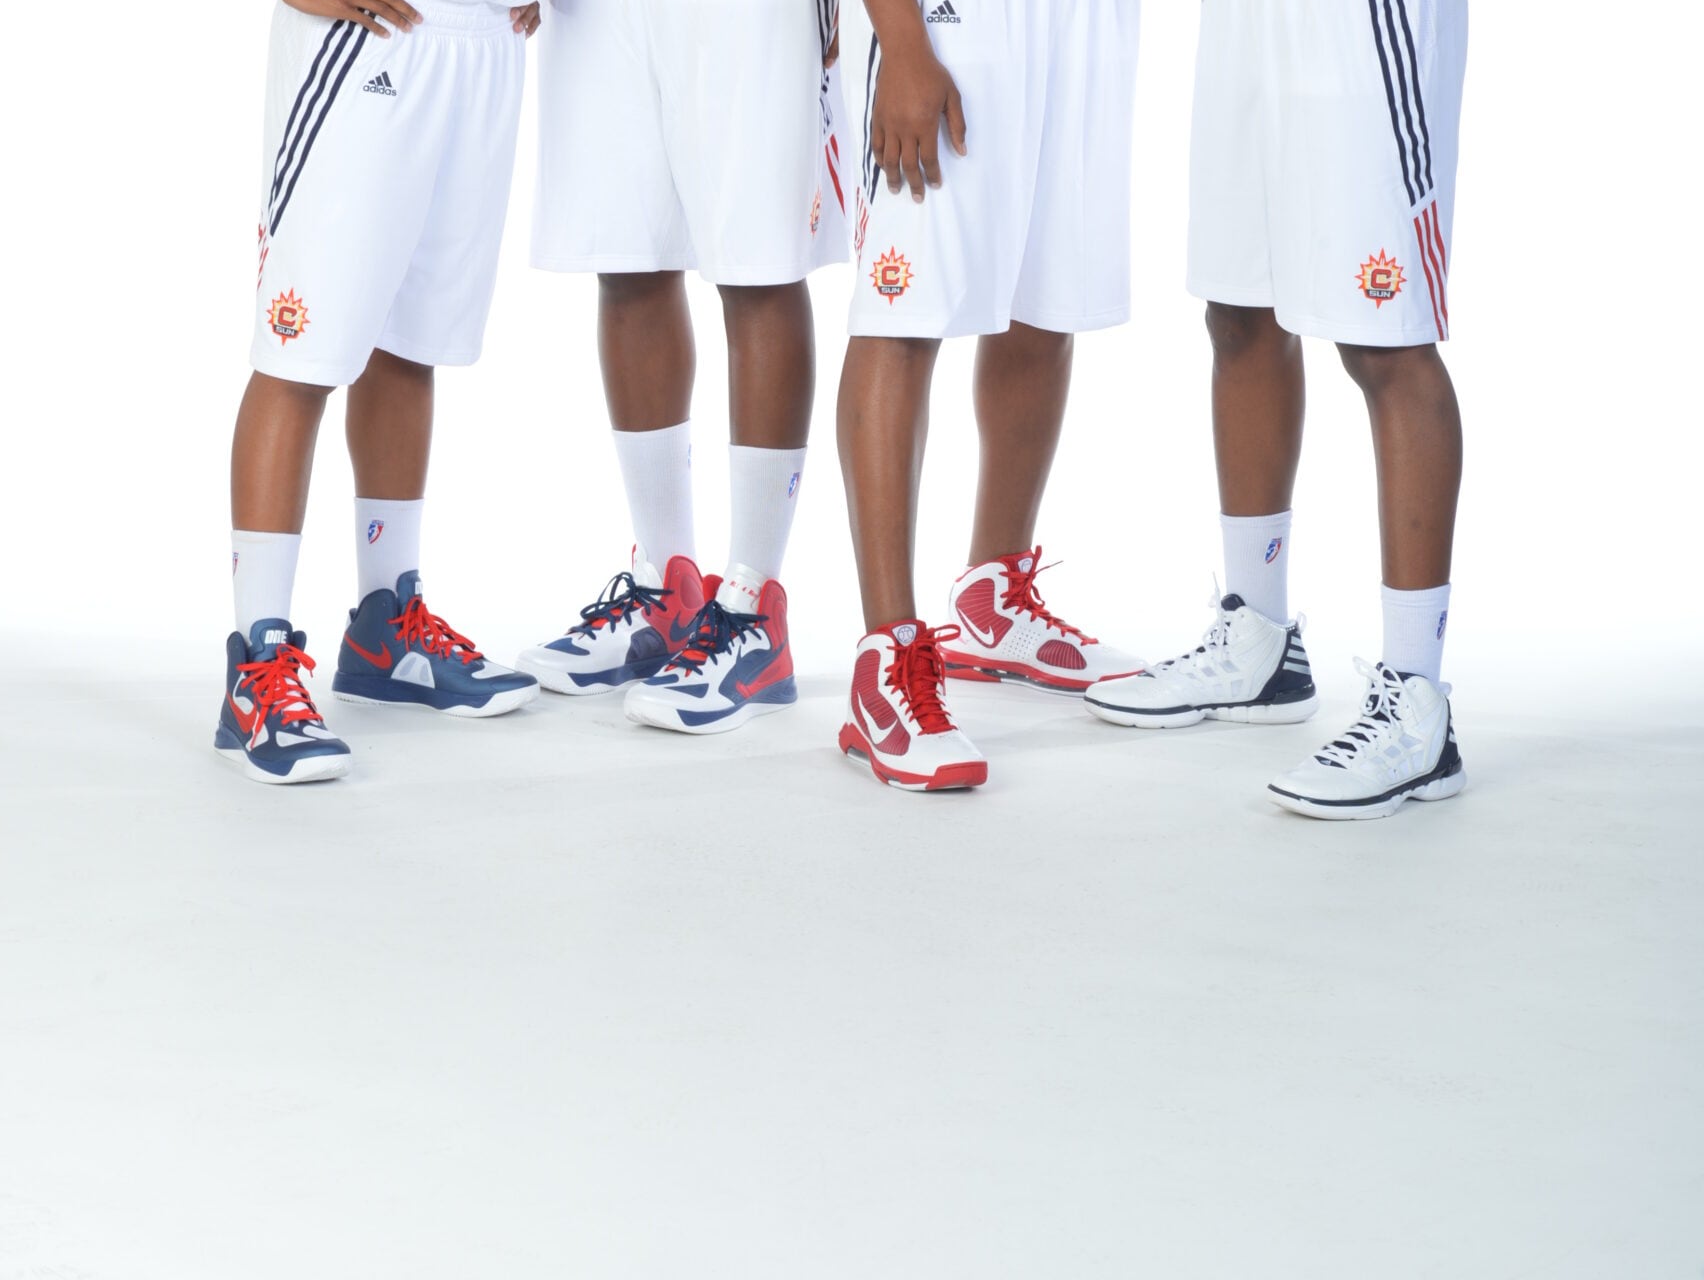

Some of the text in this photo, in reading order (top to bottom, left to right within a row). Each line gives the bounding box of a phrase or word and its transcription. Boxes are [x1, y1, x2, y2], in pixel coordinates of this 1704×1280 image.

[927, 14, 962, 24] adidas
[363, 84, 397, 97] adidas
[881, 266, 900, 285] C
[1371, 268, 1392, 289] C
[1369, 290, 1391, 298] SUN
[278, 306, 297, 327] C
